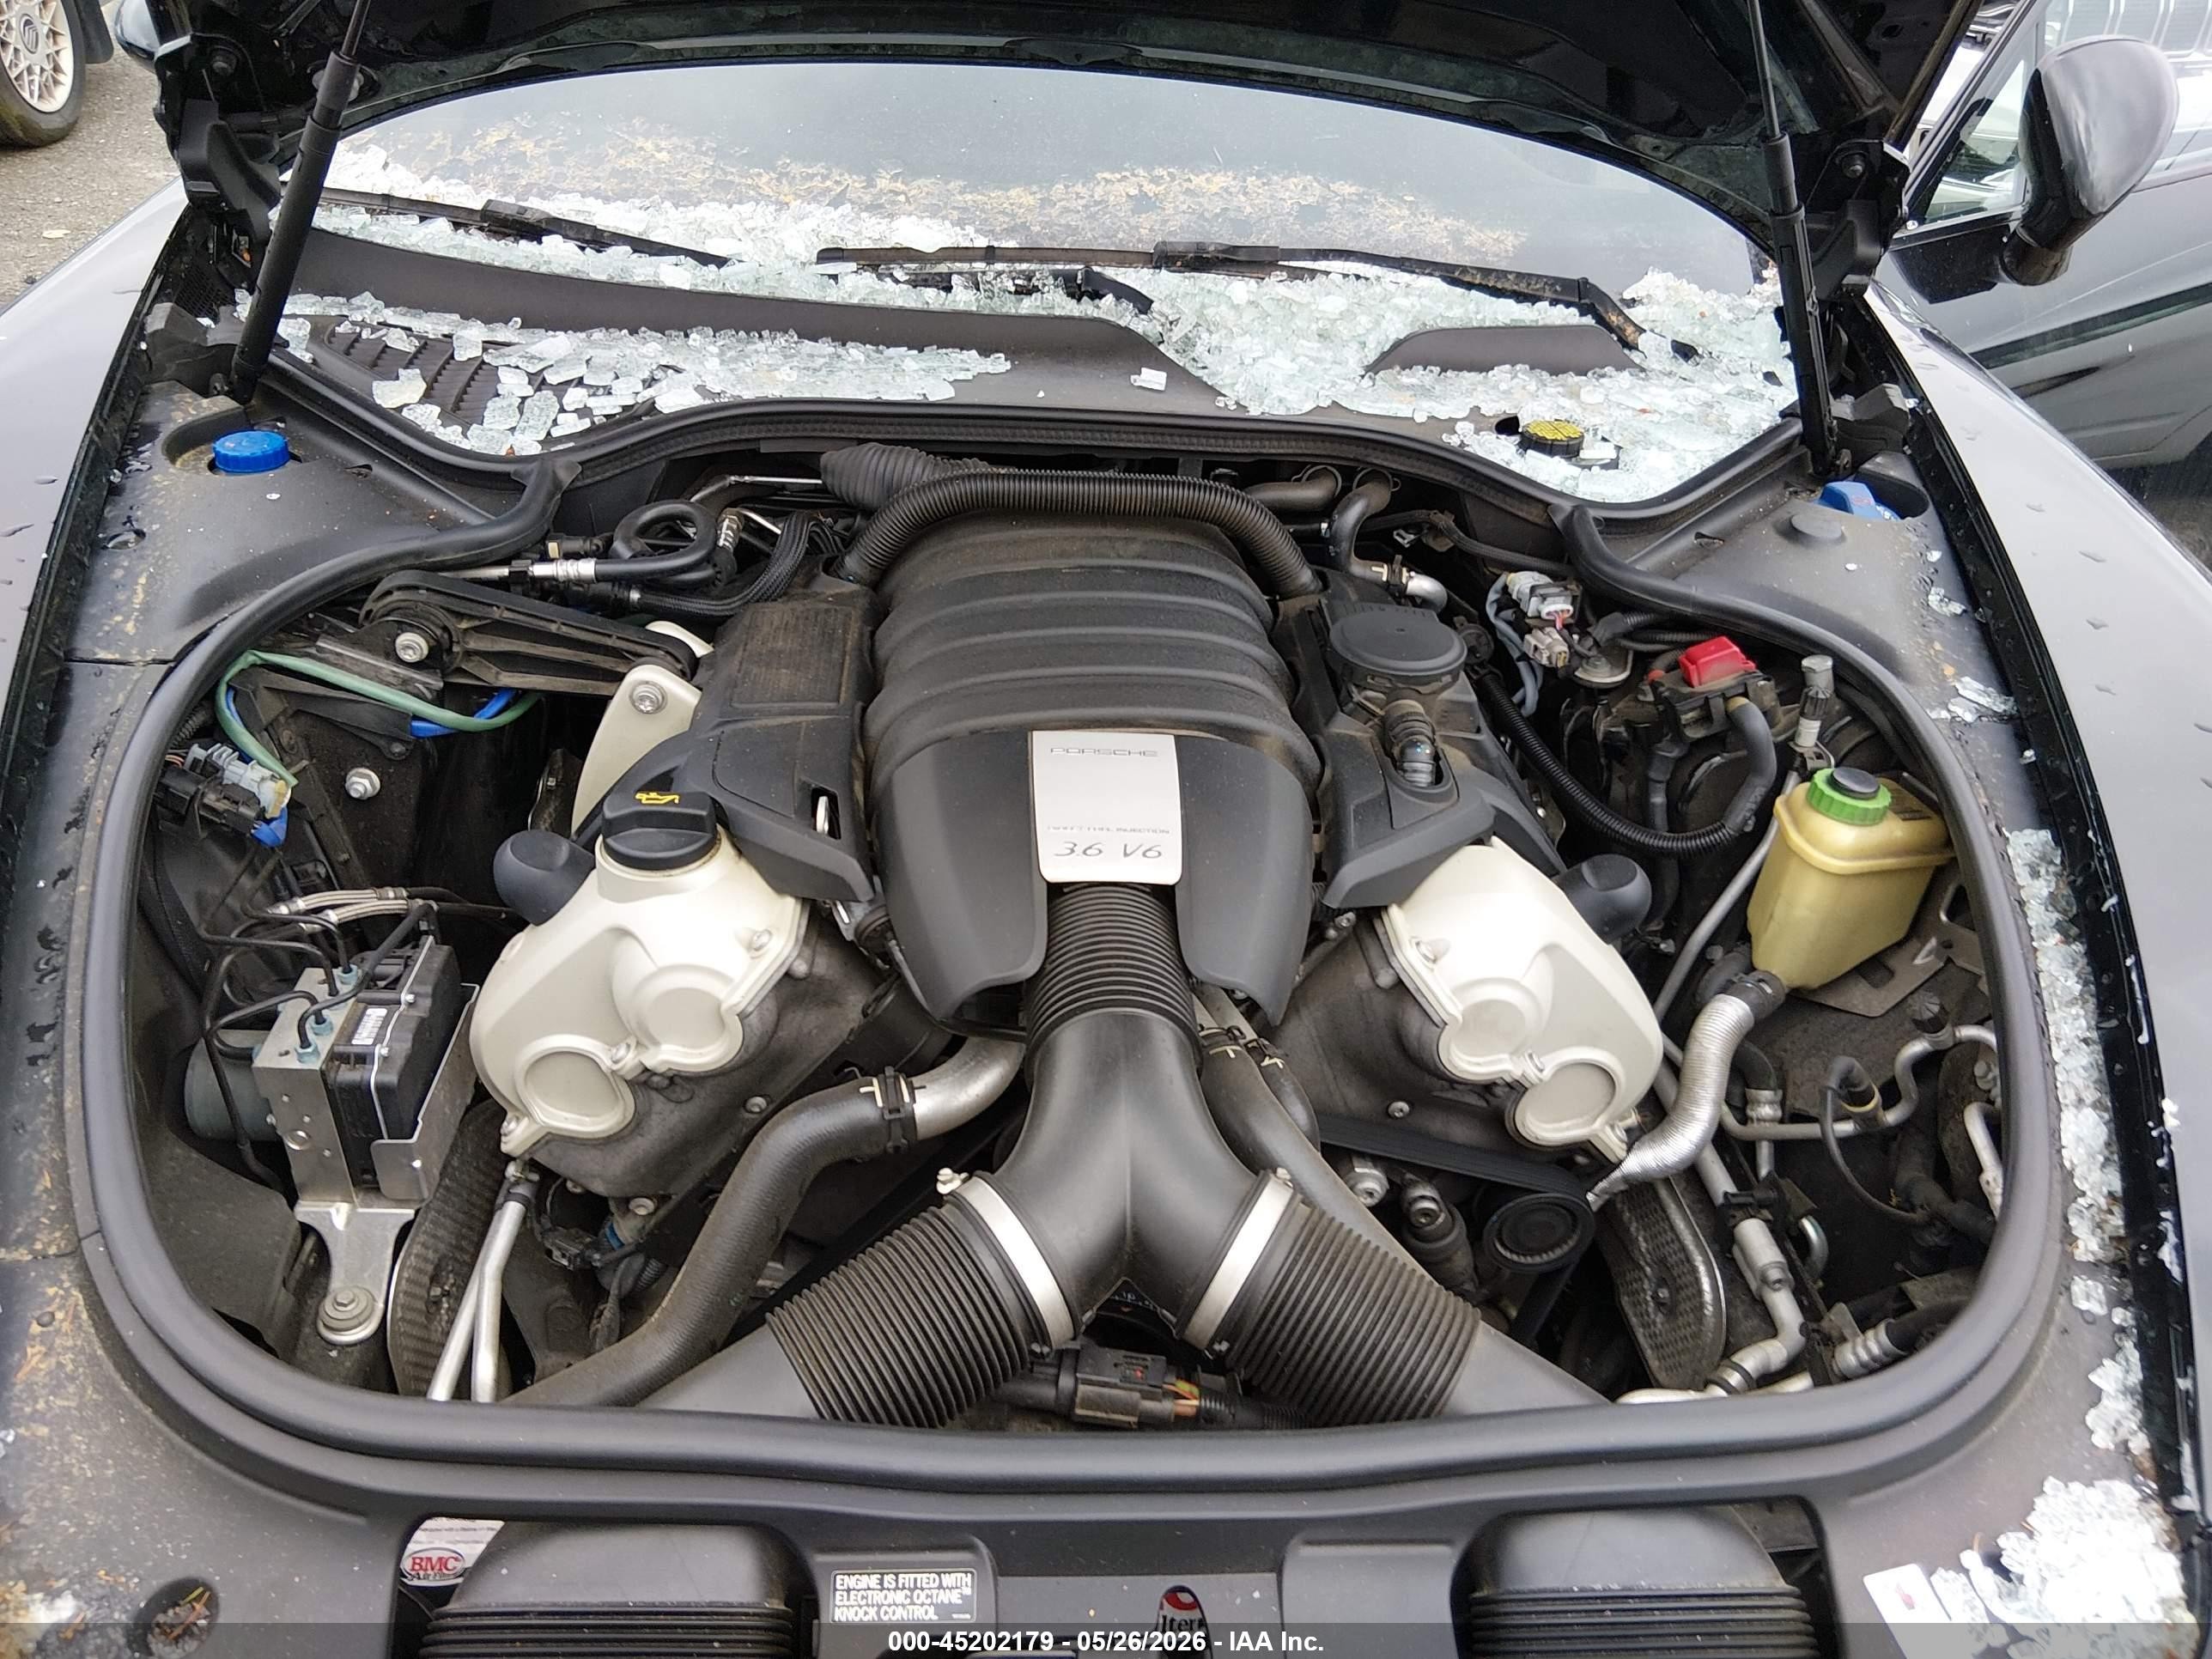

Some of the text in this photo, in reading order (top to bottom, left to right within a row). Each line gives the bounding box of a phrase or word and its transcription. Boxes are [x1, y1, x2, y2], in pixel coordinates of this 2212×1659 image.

[1050, 747, 1158, 757] PORSCHE
[1054, 841, 1163, 859] 3.6 V6
[410, 1556, 459, 1572] BMC
[836, 1572, 972, 1589] ENGINE IS FITTED WITH
[835, 1589, 911, 1606] ELECTRONIC
[834, 1606, 878, 1622] KNOCK
[879, 1604, 939, 1622] CONTROL
